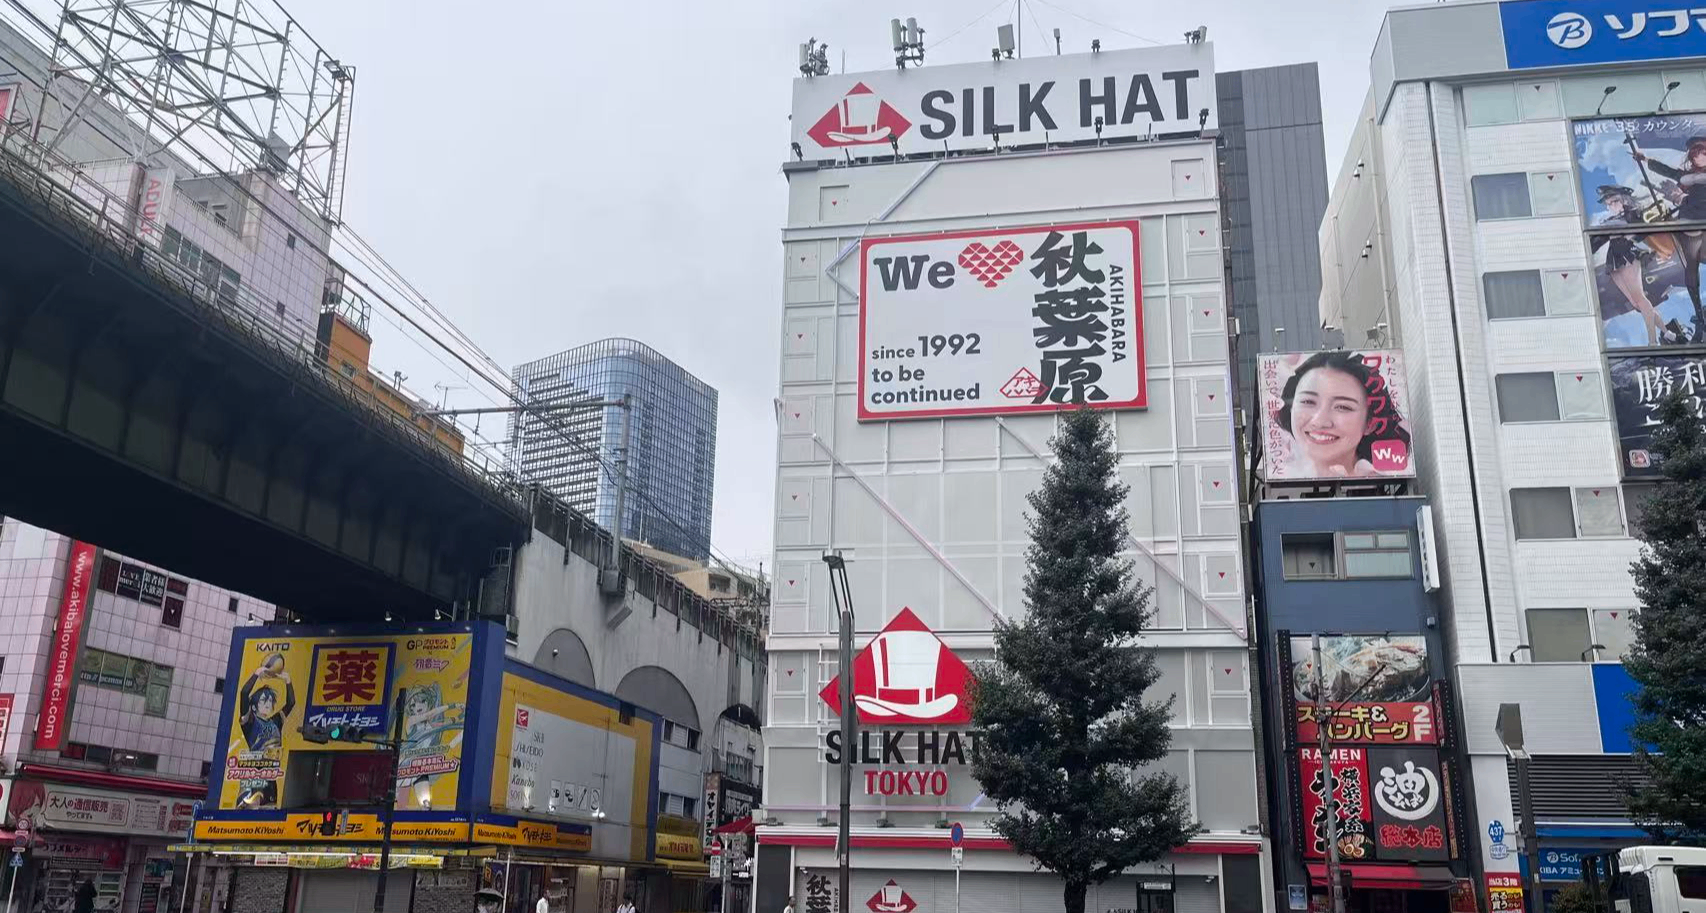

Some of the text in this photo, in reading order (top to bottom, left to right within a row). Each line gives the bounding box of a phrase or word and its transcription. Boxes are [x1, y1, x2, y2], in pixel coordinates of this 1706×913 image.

[919, 70, 1200, 140] SILK HAT
[873, 254, 956, 291] We
[1029, 231, 1110, 405] 秋葉原
[1109, 264, 1126, 363] AKIHABARA
[871, 333, 981, 360] since 1992
[872, 365, 926, 382] to be
[871, 383, 980, 405] continued
[1362, 355, 1388, 435] ワクワク
[43, 550, 88, 741] www.akibalovemerci.com
[256, 642, 290, 652] KAITO
[323, 650, 379, 703] 薬
[514, 742, 544, 758] SHISEIDO
[825, 730, 985, 764] SILK HAT
[1301, 748, 1361, 760] RAMEN
[864, 770, 948, 796] TOKYO
[49, 796, 109, 813] 大人の通信販売
[208, 826, 285, 835] Matsumoto KiYoshi
[375, 826, 456, 836] Msumoto KiYoshi
[1380, 824, 1443, 848] 総本店
[1490, 826, 1502, 835] 437
